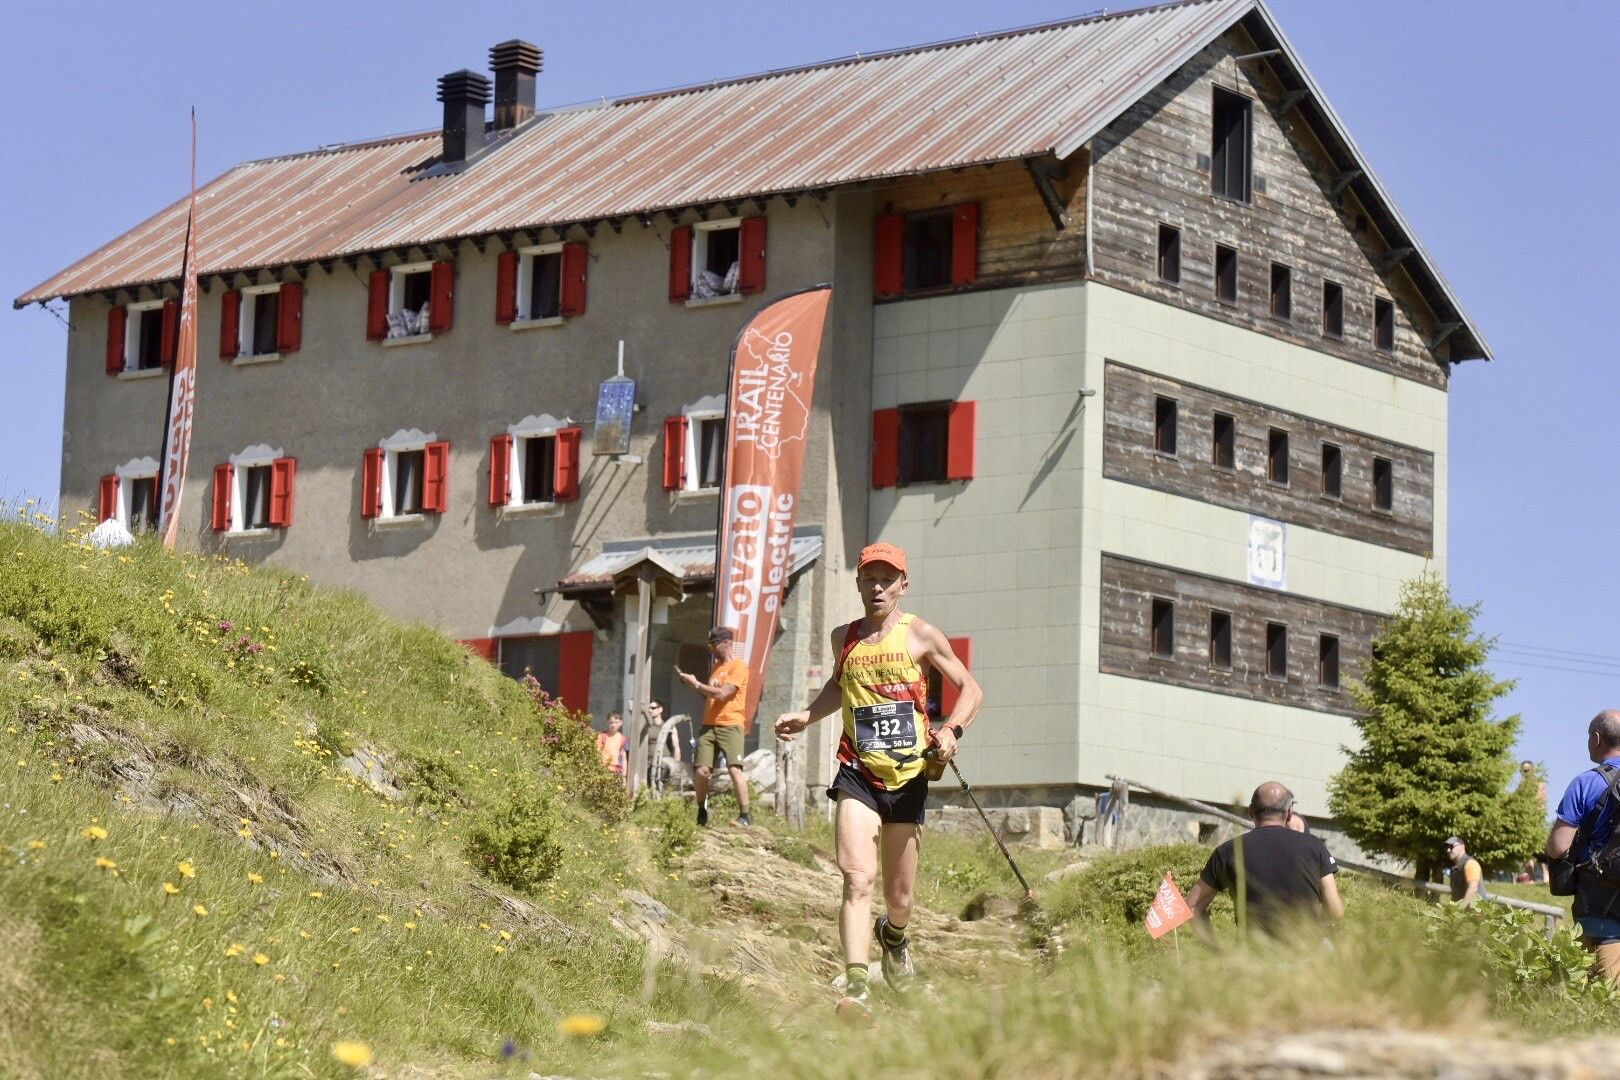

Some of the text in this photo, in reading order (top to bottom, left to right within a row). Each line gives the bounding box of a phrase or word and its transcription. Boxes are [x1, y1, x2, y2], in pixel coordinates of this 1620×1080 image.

[736, 363, 769, 447] TRAIL
[761, 331, 792, 447] CENTENARIO
[764, 493, 793, 613] electric
[847, 652, 904, 669] pegarun
[872, 719, 901, 736] 132
